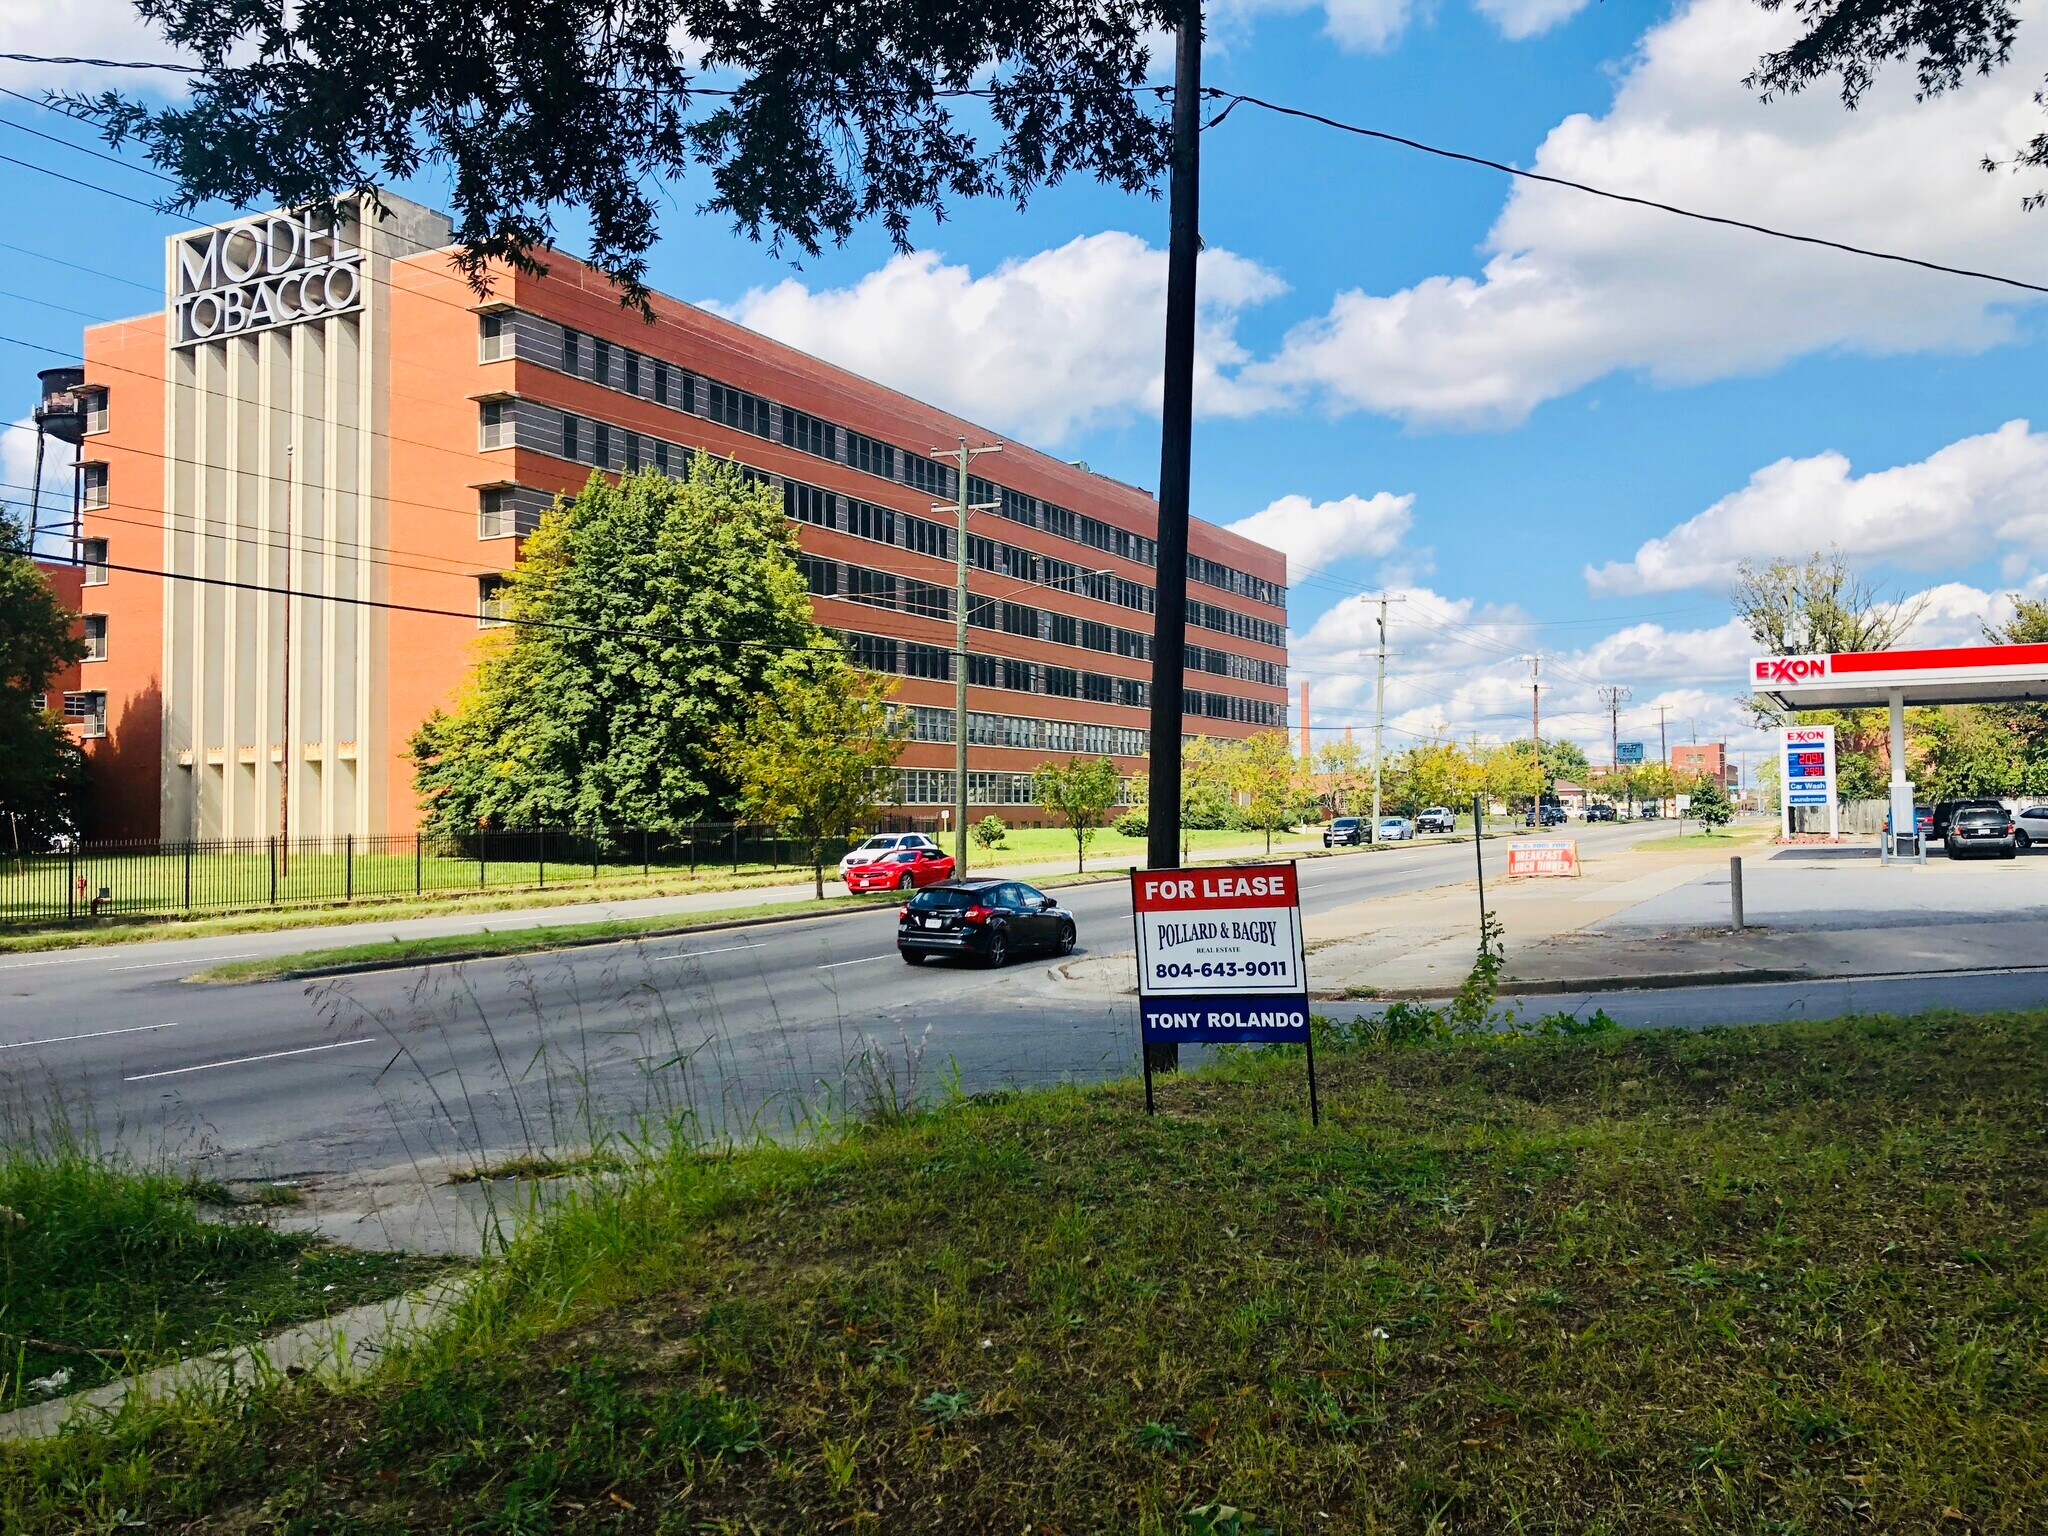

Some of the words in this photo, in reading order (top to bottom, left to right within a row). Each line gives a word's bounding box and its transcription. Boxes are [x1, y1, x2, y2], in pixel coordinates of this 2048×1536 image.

[177, 201, 360, 296] MODEL
[172, 261, 361, 343] TOBACCO
[1756, 659, 1825, 684] EXXON
[1787, 730, 1824, 743] EXXON
[1805, 782, 1825, 790] Wash
[1790, 795, 1826, 803] Laundromat
[1514, 850, 1563, 862] BREAKFAST
[1510, 861, 1535, 873] LUNCH
[1537, 861, 1570, 873] DINNER
[1145, 880, 1196, 900] FOR
[1203, 876, 1285, 898] LEASE
[1157, 922, 1218, 951] POLLARD
[1220, 921, 1230, 939] &
[1232, 921, 1277, 947] BAGBY
[1156, 961, 1287, 978] 804-643-9011
[1147, 1012, 1201, 1029] TONY
[1207, 1011, 1304, 1028] ROLANDO
